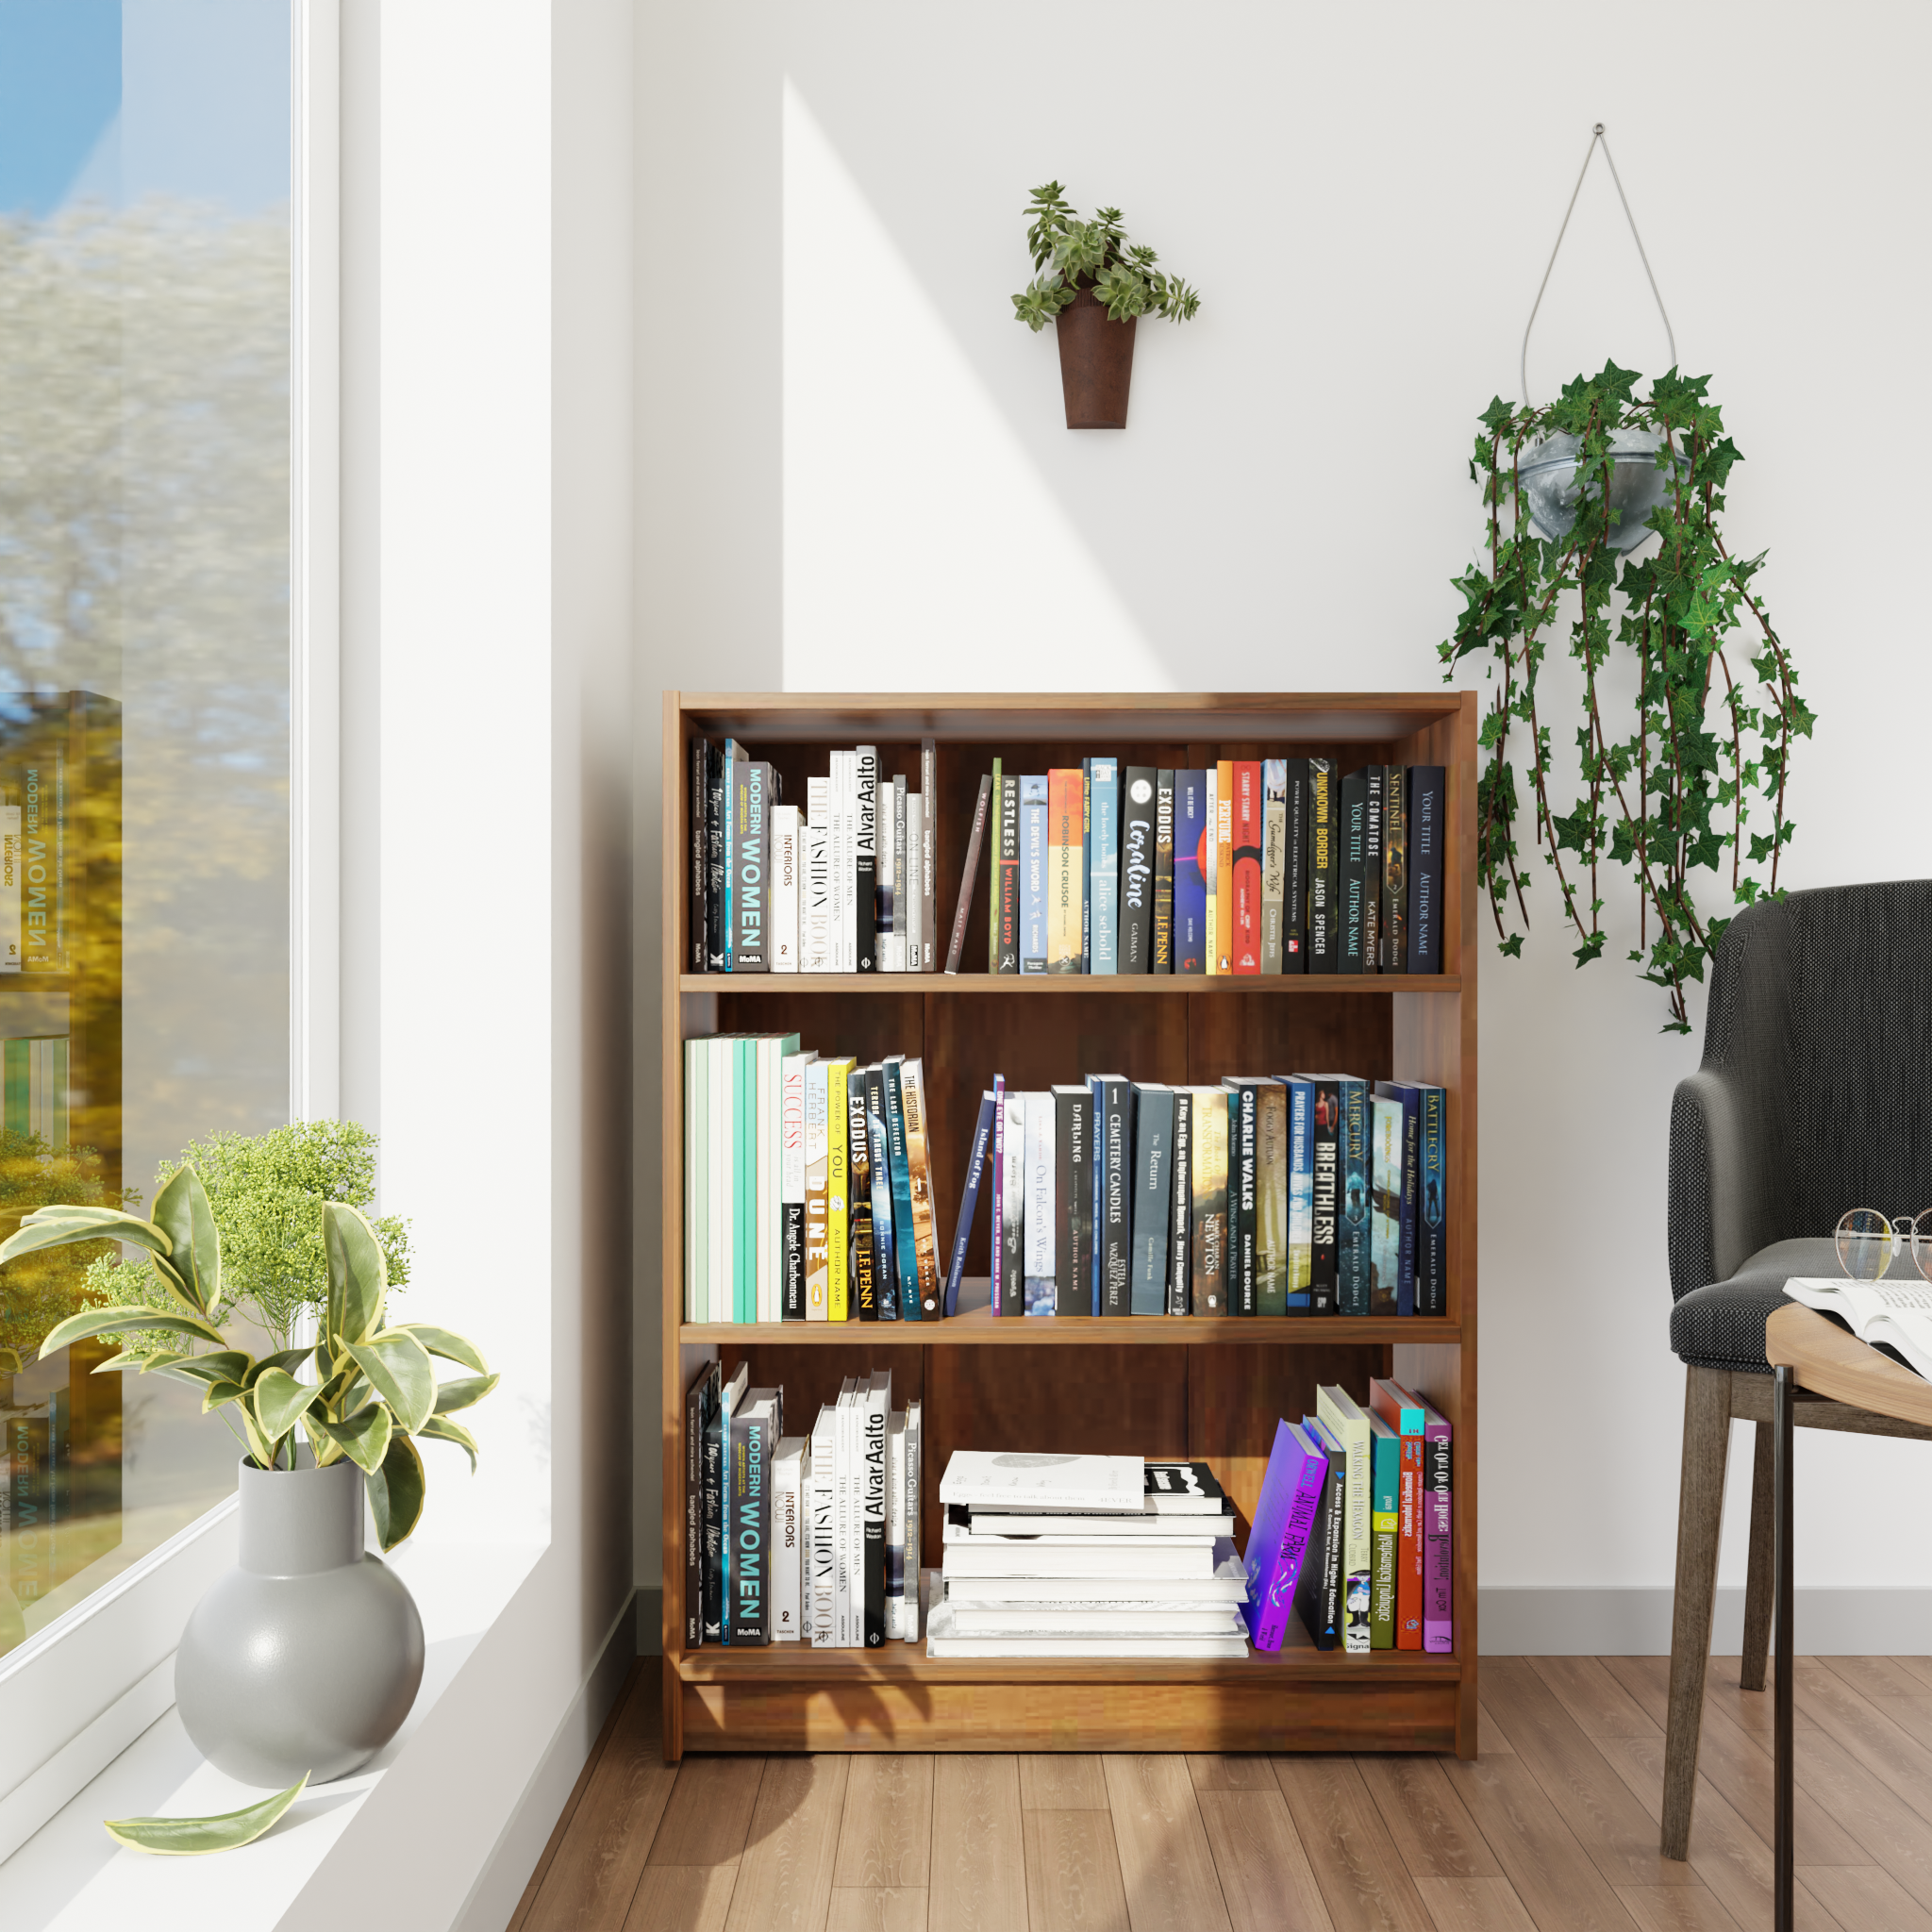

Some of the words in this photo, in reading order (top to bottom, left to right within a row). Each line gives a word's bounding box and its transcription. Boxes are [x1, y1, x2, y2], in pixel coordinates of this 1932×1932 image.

[858, 757, 874, 803] Aalto
[1317, 773, 1327, 823] UNKNOWN
[1370, 776, 1380, 794] THE
[750, 769, 760, 834] MODERN
[811, 781, 826, 820] THE
[1004, 780, 1015, 857] RESTLESS
[1031, 808, 1040, 824] THE
[1158, 789, 1172, 843] EXODUS
[1351, 803, 1363, 832] YOUR
[1423, 791, 1433, 822] YOUR
[858, 806, 874, 850] Alvar
[895, 821, 904, 855] Guitars
[1099, 817, 1108, 841] lovely
[1219, 800, 1230, 842] PERFUME
[1368, 801, 1378, 857] COMATOSE
[1421, 825, 1431, 855] TITLE
[909, 834, 918, 851] ON
[1031, 826, 1040, 857] DEVIL'S
[1317, 828, 1327, 869] BORDER
[1351, 836, 1361, 862] TITLE
[811, 826, 826, 908] FASHION
[909, 858, 918, 886] LINE
[1030, 859, 1040, 891] SWORD
[1126, 821, 1150, 910] Coraline
[741, 839, 760, 946] WOMEN
[1004, 868, 1012, 912] WILLIAM
[1099, 880, 1109, 910] alice
[1315, 878, 1324, 907] JASON
[1349, 879, 1361, 923] AUTHOR
[1420, 873, 1430, 920] AUTHOR
[810, 915, 826, 967] BOOK
[1099, 915, 1111, 960] sebold
[1269, 909, 1277, 941] CHRISTEL
[1315, 914, 1324, 954] SPENCER
[1348, 926, 1358, 957] NAME
[1419, 924, 1428, 955] NAME
[1366, 930, 1375, 965] MYERS
[905, 1075, 915, 1089] THE
[784, 1075, 802, 1148] SUCCESS
[850, 1097, 866, 1163] EXODUS
[906, 1092, 919, 1132] HISTORIAN
[1242, 1091, 1253, 1155] CHARLIE
[1265, 1107, 1276, 1133] FOGGY
[1349, 1091, 1362, 1161] MERCURY
[975, 1128, 988, 1158] Island
[1072, 1104, 1082, 1162] DARLING
[1110, 1114, 1121, 1170] CEMETERY
[1265, 1136, 1274, 1164] AUTUMN
[1427, 1094, 1439, 1173] BATTLECRY
[969, 1173, 980, 1189] Fog
[974, 1160, 982, 1170] of
[1036, 1165, 1046, 1183] On
[1149, 1151, 1161, 1189] Return
[1242, 1158, 1253, 1210] WALKS
[1036, 1188, 1047, 1233] Falcon's
[1109, 1173, 1121, 1223] CANDLES
[1314, 1142, 1336, 1244] BREATHLESS
[809, 1176, 824, 1260] DUNE
[1034, 1237, 1047, 1272] Wings
[1205, 1213, 1214, 1275] NEWTON
[1352, 1231, 1360, 1272] EMERALD
[749, 1426, 760, 1496] MODERN
[815, 1441, 833, 1482] THE
[908, 1442, 916, 1476] Picasso
[1300, 1459, 1319, 1487] ORWELL
[1353, 1441, 1364, 1479] WALKING
[907, 1479, 916, 1516] Guitars
[1335, 1483, 1343, 1507] Access
[1353, 1481, 1363, 1498] THE
[786, 1491, 794, 1547] INTERIORS
[1289, 1490, 1316, 1530] ANIMAL
[1352, 1500, 1364, 1540] HEXAGON
[815, 1490, 833, 1577] FASHION
[1280, 1533, 1305, 1559] FARM
[1331, 1517, 1341, 1553] Expansion
[741, 1501, 759, 1618] WOMEN
[1360, 1548, 1369, 1562] TERRY
[1329, 1564, 1338, 1587] Higher
[814, 1586, 833, 1643] BOOK
[1327, 1589, 1337, 1624] Education
